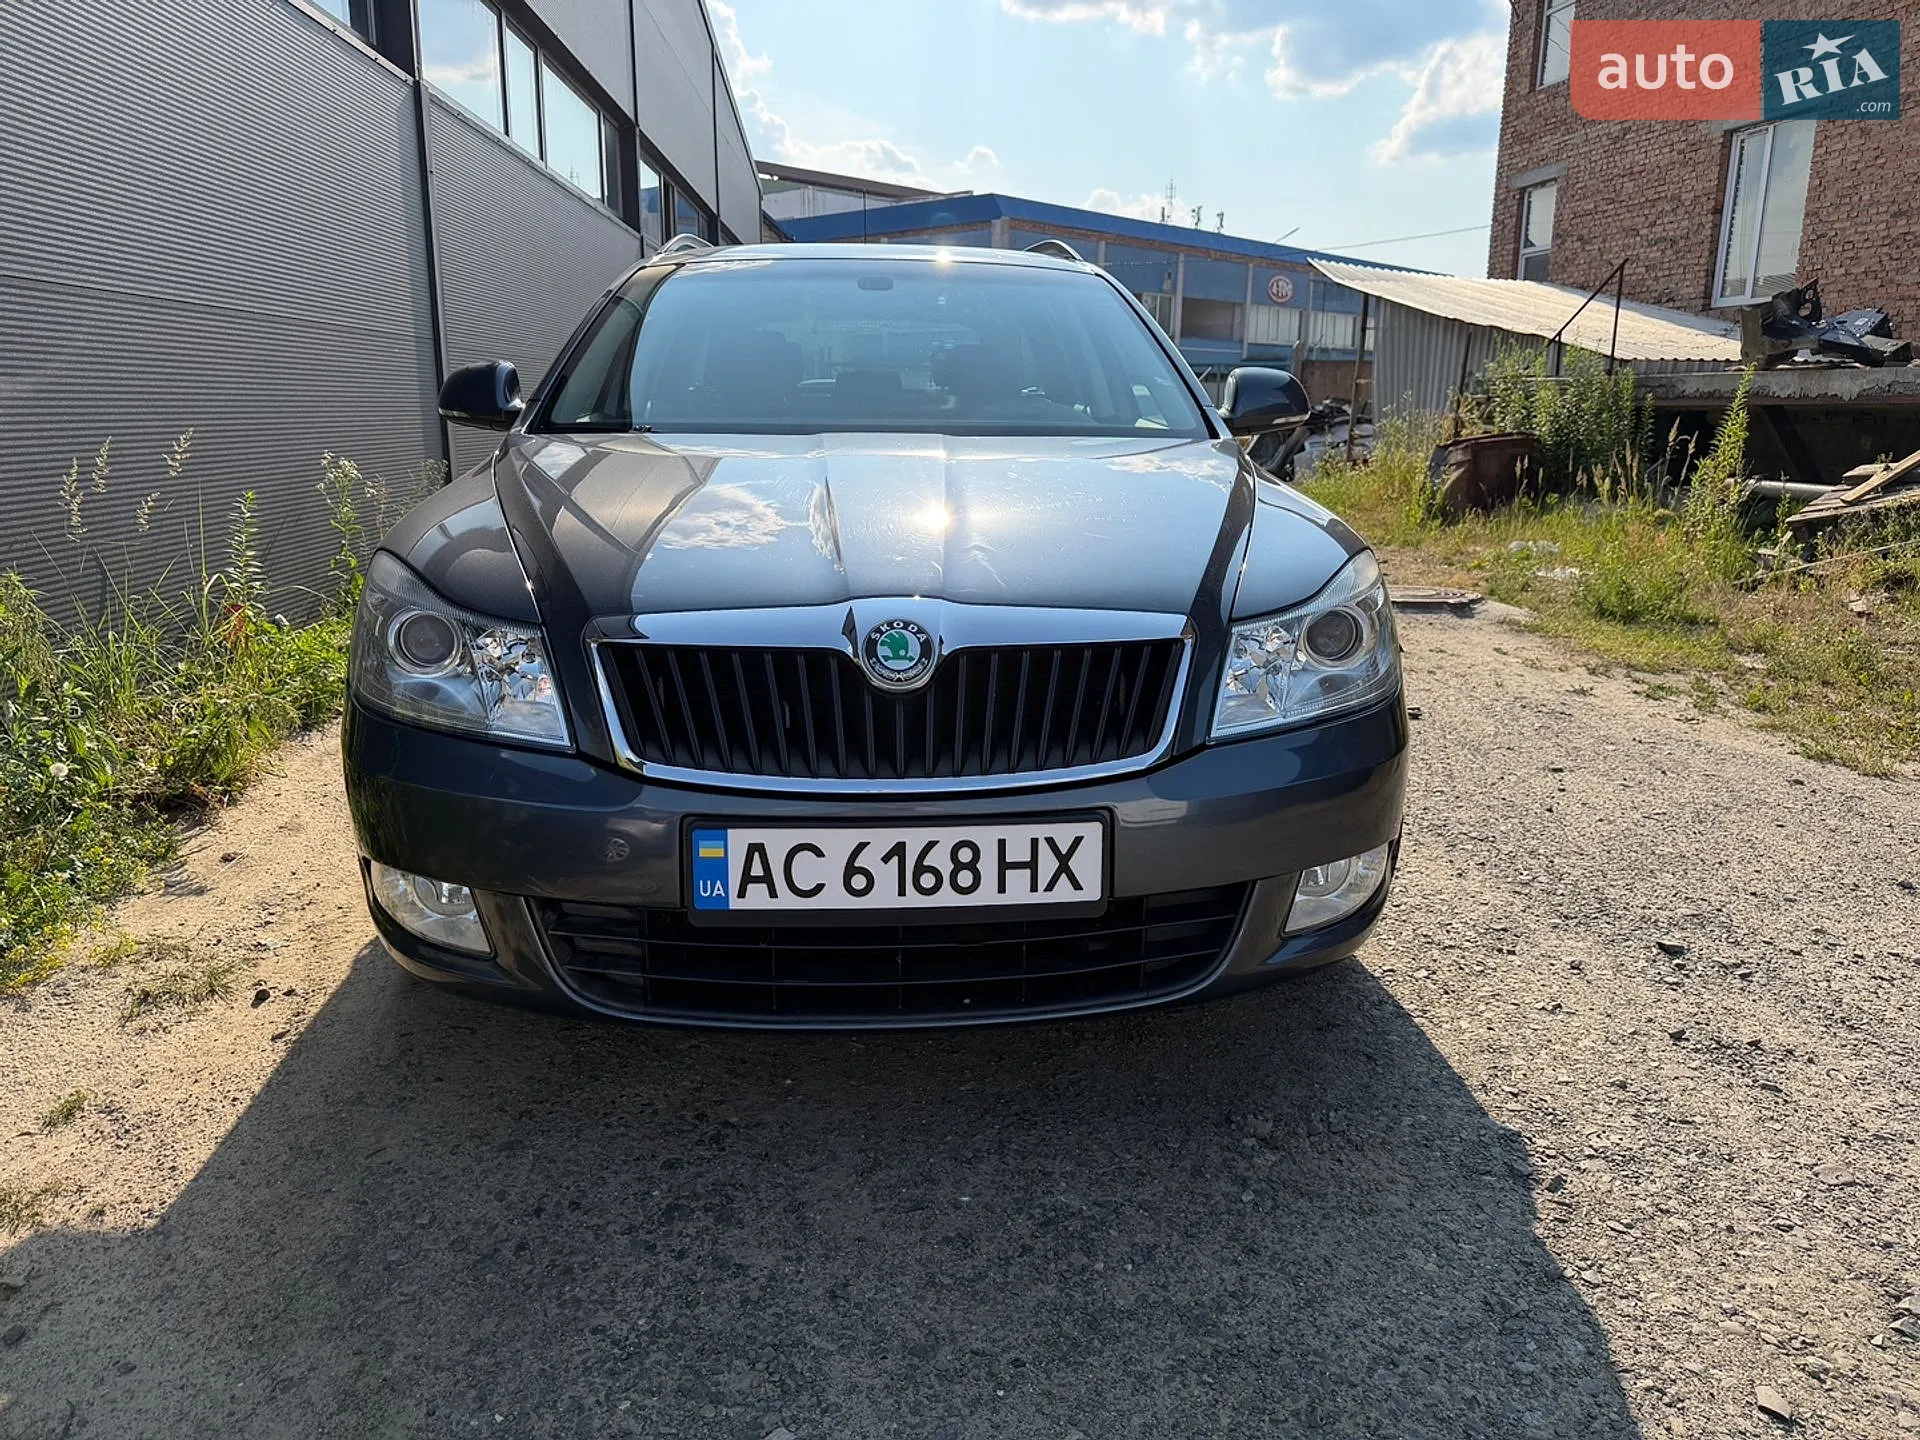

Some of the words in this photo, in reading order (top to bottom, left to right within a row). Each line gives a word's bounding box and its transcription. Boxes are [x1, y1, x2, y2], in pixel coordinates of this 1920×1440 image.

[736, 841, 827, 899] AC
[842, 839, 981, 898] 6168
[997, 835, 1085, 895] HX
[699, 879, 726, 897] UA
